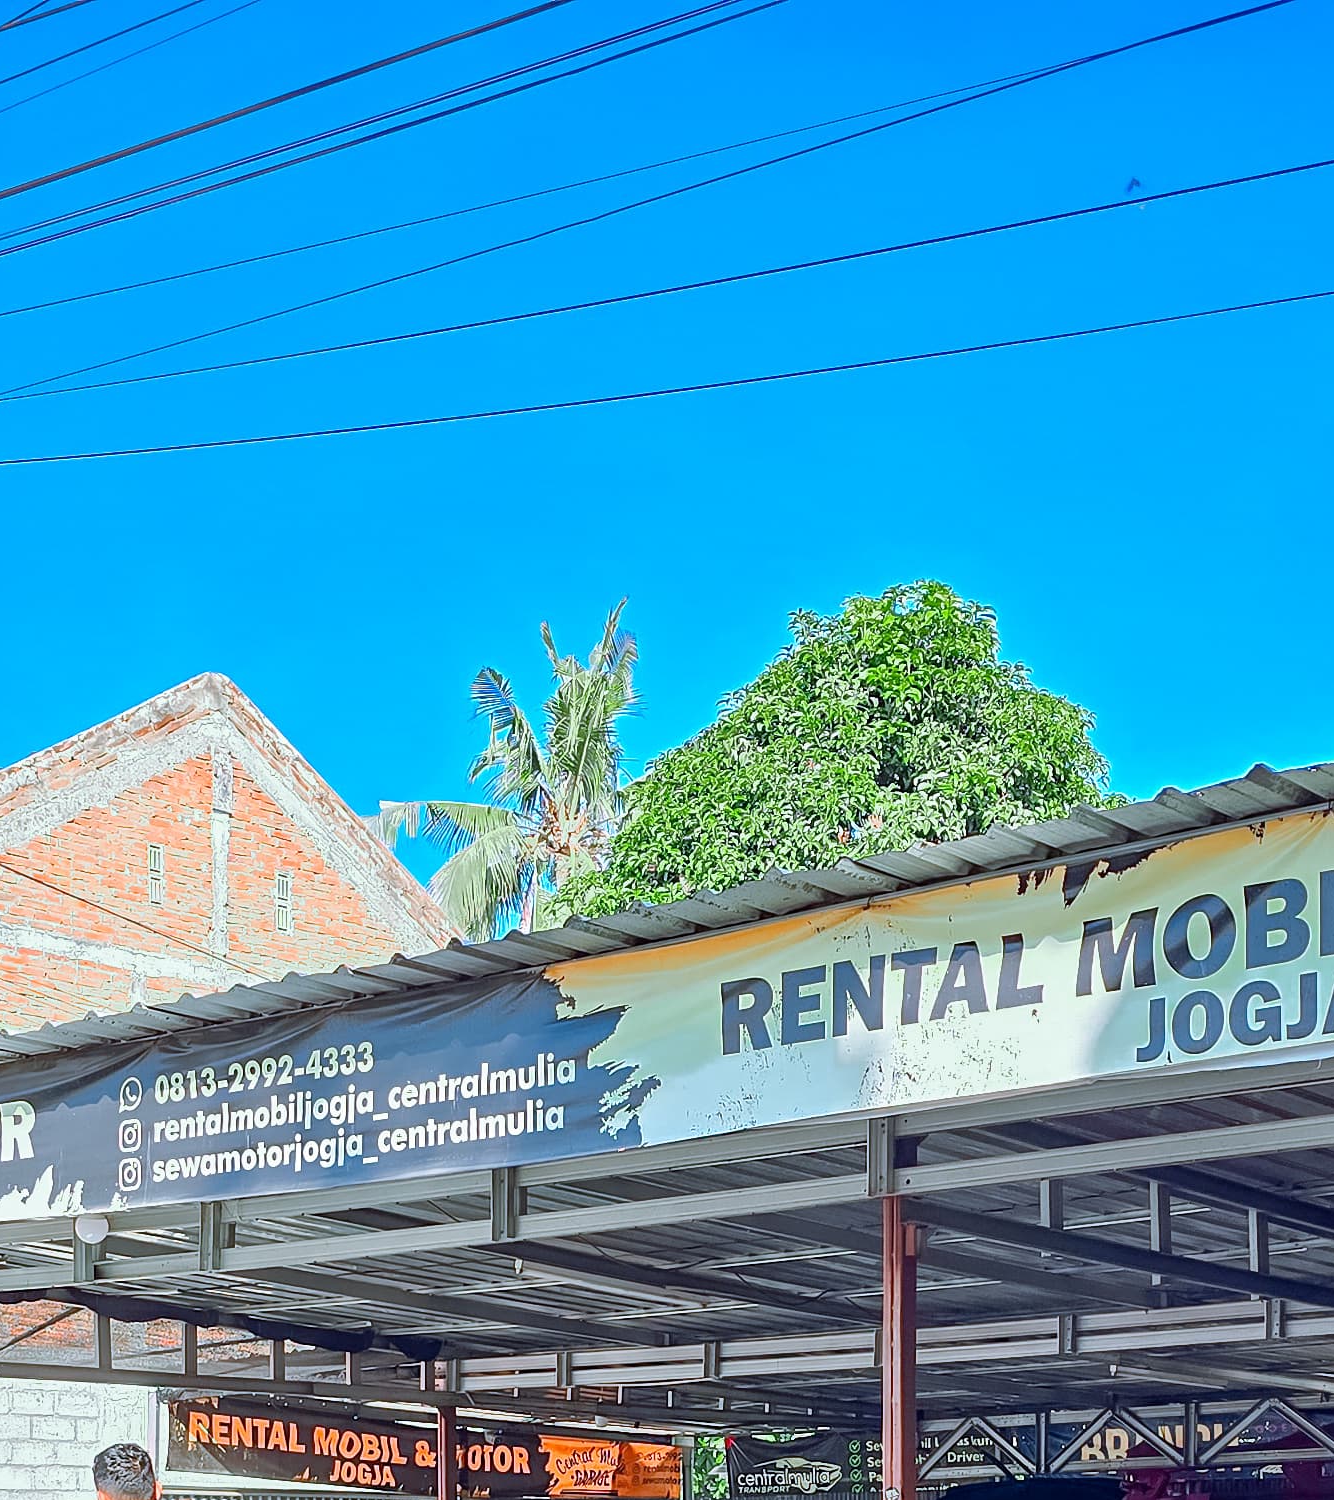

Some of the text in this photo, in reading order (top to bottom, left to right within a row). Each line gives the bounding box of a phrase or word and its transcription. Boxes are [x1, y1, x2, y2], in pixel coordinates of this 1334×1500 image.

[720, 933, 1044, 1056] RENTAL
[153, 1041, 376, 1105] 0813-2992-4333
[153, 1053, 577, 1144] rentalmobiljogja_centralmulia
[152, 1099, 565, 1183] sewamotorjogja_centralmulia
[189, 1411, 306, 1453] RENTAL
[314, 1426, 407, 1465] MOBIL
[415, 1440, 437, 1468] &
[947, 1452, 985, 1463] Driver
[330, 1460, 396, 1488] JOGJA
[739, 1484, 791, 1494] TRANSPORT
